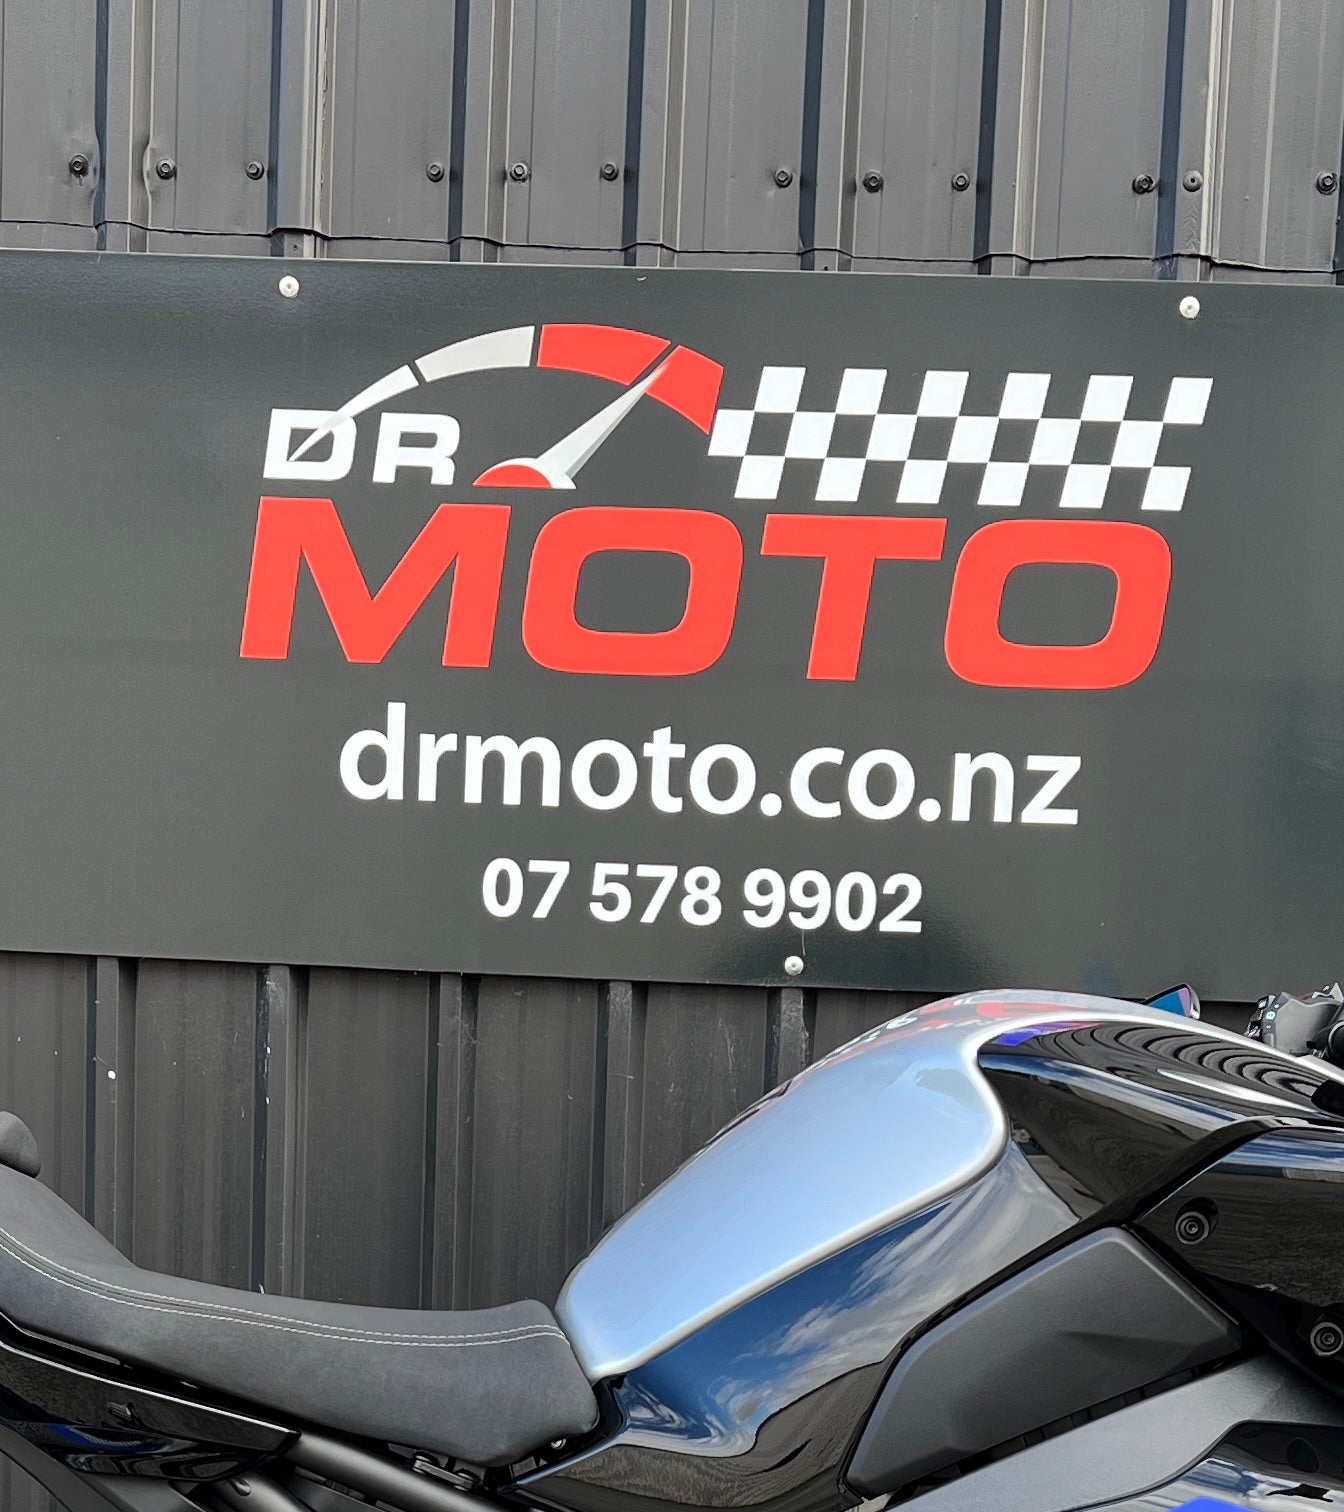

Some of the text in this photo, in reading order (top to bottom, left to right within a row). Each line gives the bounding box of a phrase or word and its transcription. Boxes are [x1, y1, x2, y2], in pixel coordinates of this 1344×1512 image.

[263, 408, 460, 486] DR
[240, 496, 1173, 689] MOTO
[339, 701, 1082, 825] drmoto.co.nz
[482, 857, 923, 934] 07 578 9902
